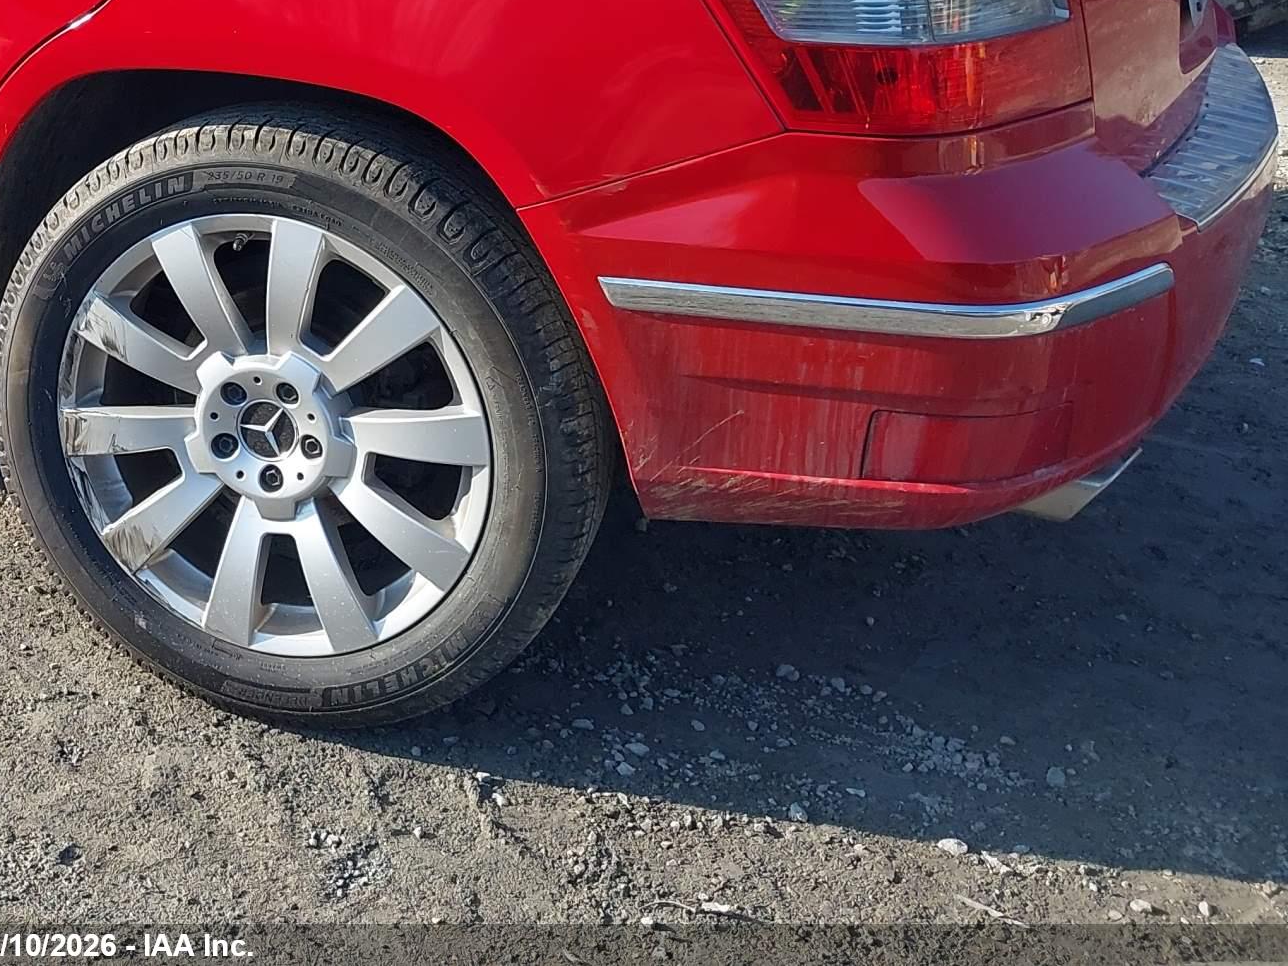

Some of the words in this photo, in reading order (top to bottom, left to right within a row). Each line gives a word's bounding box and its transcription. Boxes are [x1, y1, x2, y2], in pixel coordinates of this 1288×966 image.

[207, 170, 253, 182] 235/50
[257, 172, 266, 182] R
[271, 174, 285, 184] 19
[62, 175, 186, 262] MICHELIN
[329, 630, 469, 707] MICHELIN
